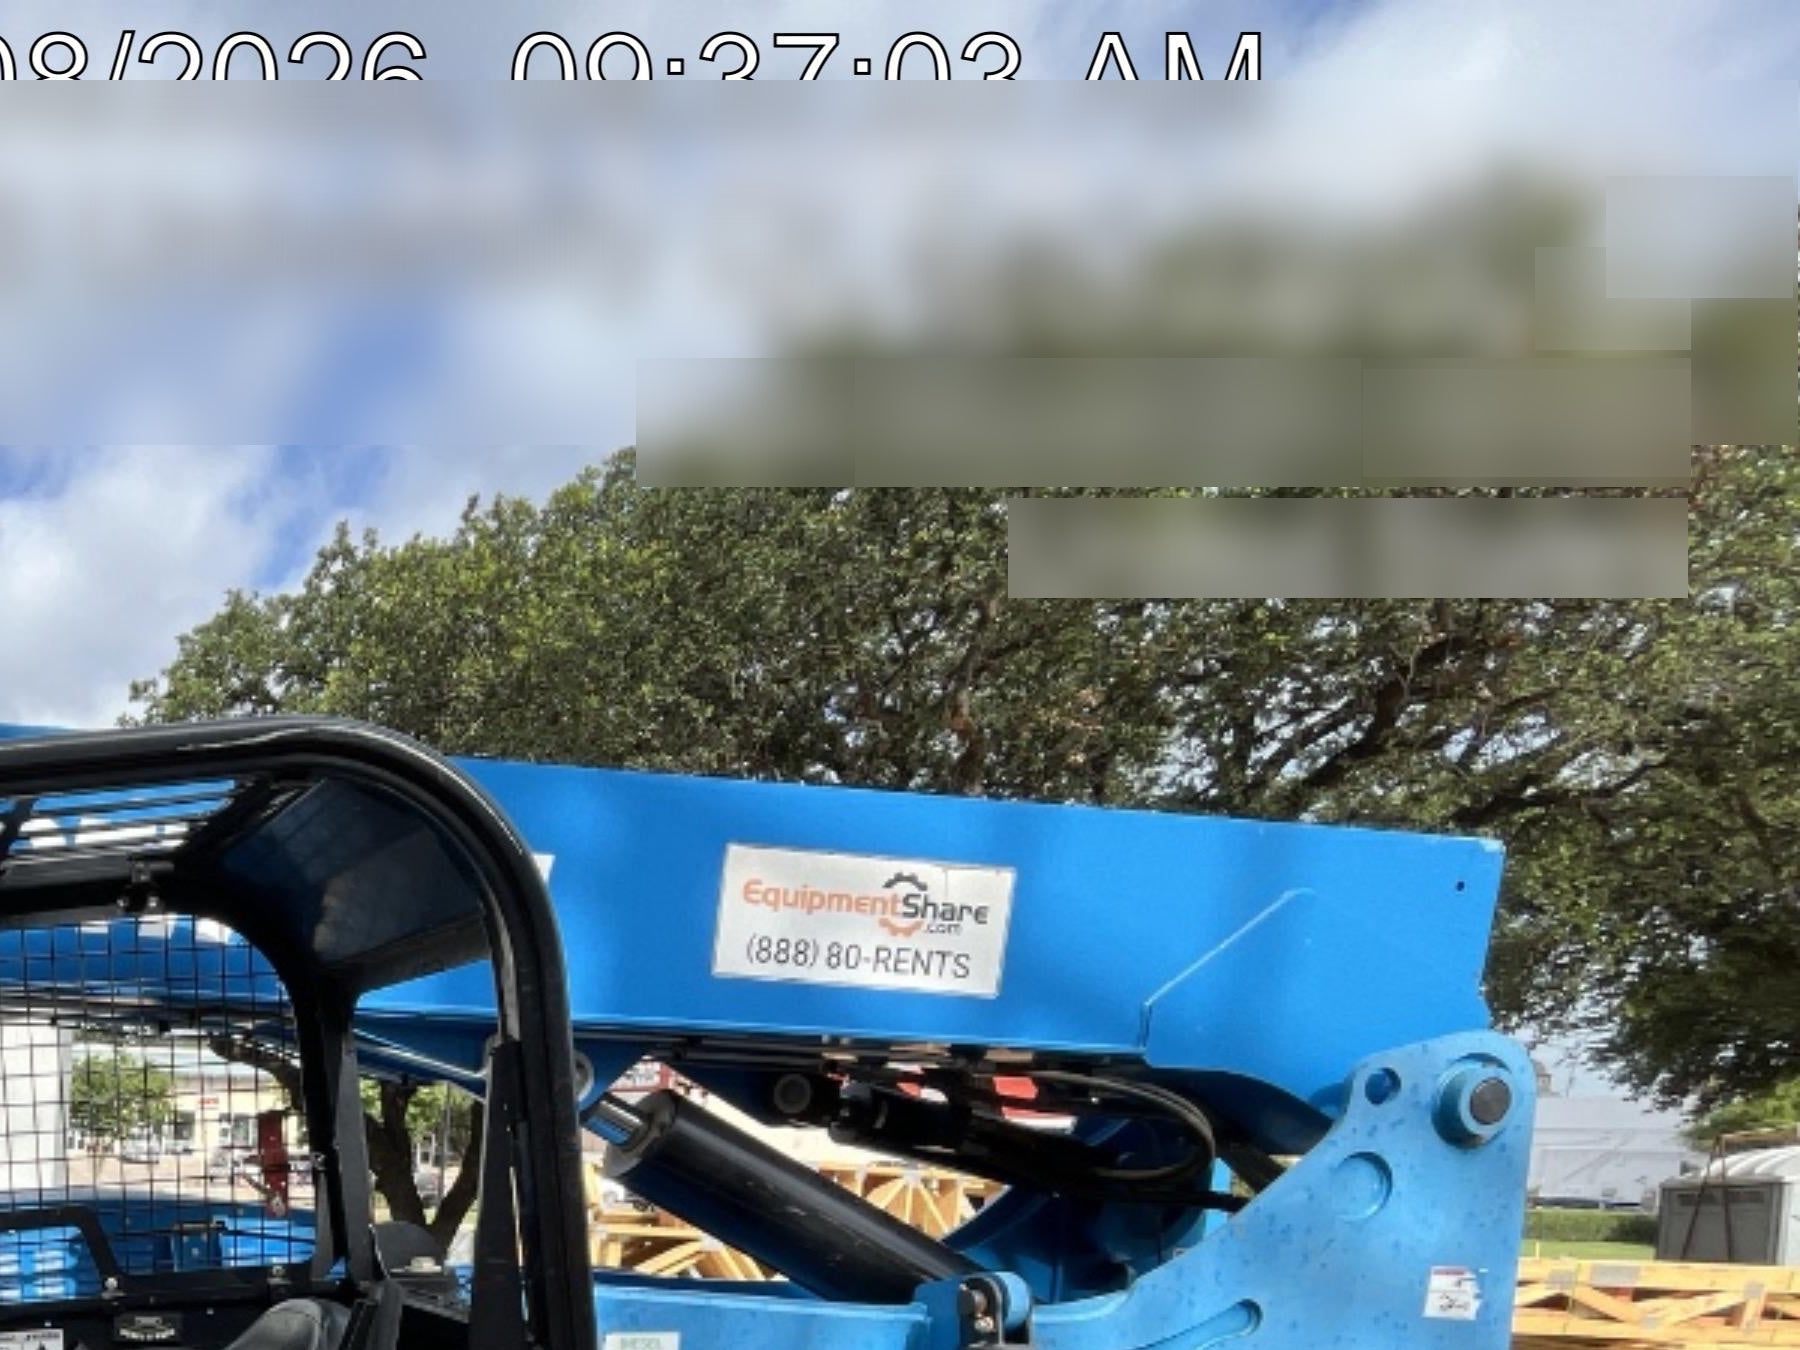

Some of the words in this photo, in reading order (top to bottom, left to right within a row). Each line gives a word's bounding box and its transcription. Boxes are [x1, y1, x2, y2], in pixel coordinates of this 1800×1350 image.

[742, 878, 989, 925] EquipmentShare
[745, 932, 821, 969] (888)
[826, 941, 971, 979] 80-RENTS
